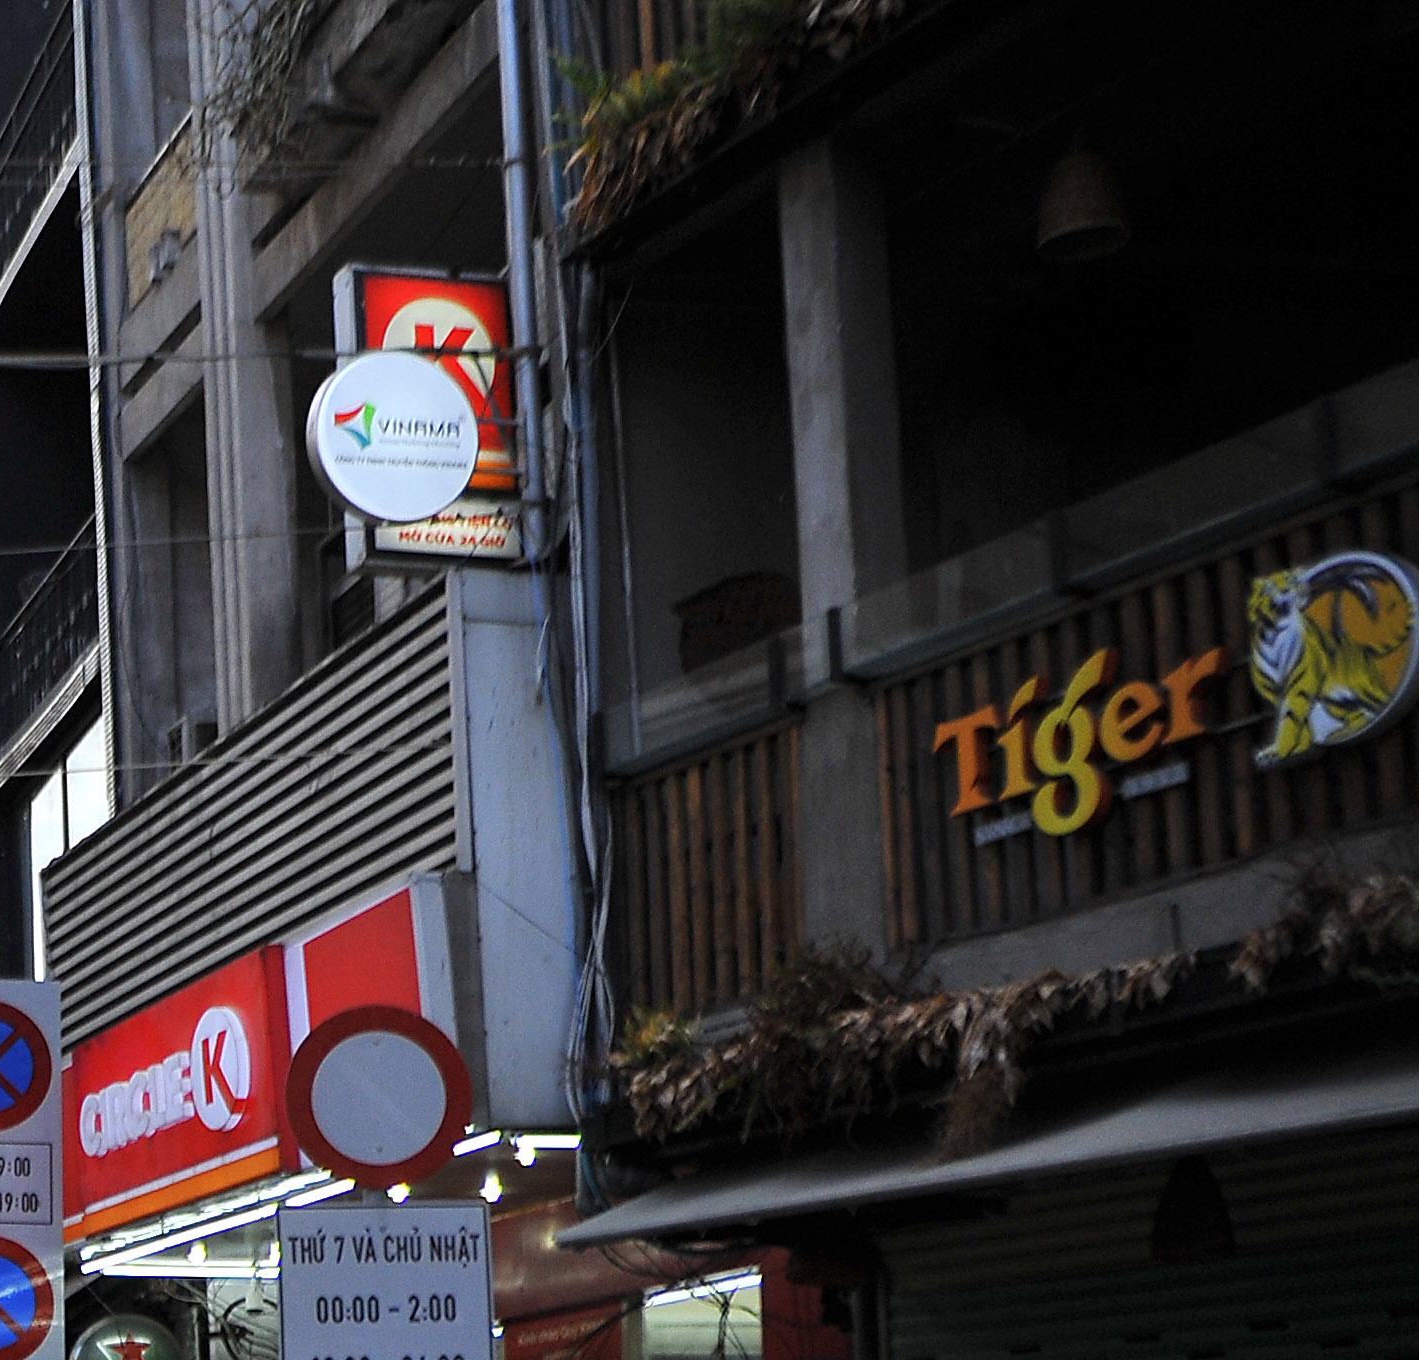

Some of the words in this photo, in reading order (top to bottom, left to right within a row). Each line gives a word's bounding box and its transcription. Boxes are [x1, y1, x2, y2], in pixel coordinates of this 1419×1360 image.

[933, 647, 1228, 837] Tiger
[80, 1050, 195, 1157] CIRCLE
[288, 1229, 326, 1264] THỨ
[334, 1236, 345, 1264] 7
[352, 1228, 377, 1264] VÀ
[382, 1228, 422, 1264] CHỦ
[429, 1226, 480, 1268] NHẬT
[316, 1296, 380, 1324] 00:00
[408, 1294, 457, 1324] 2:00
